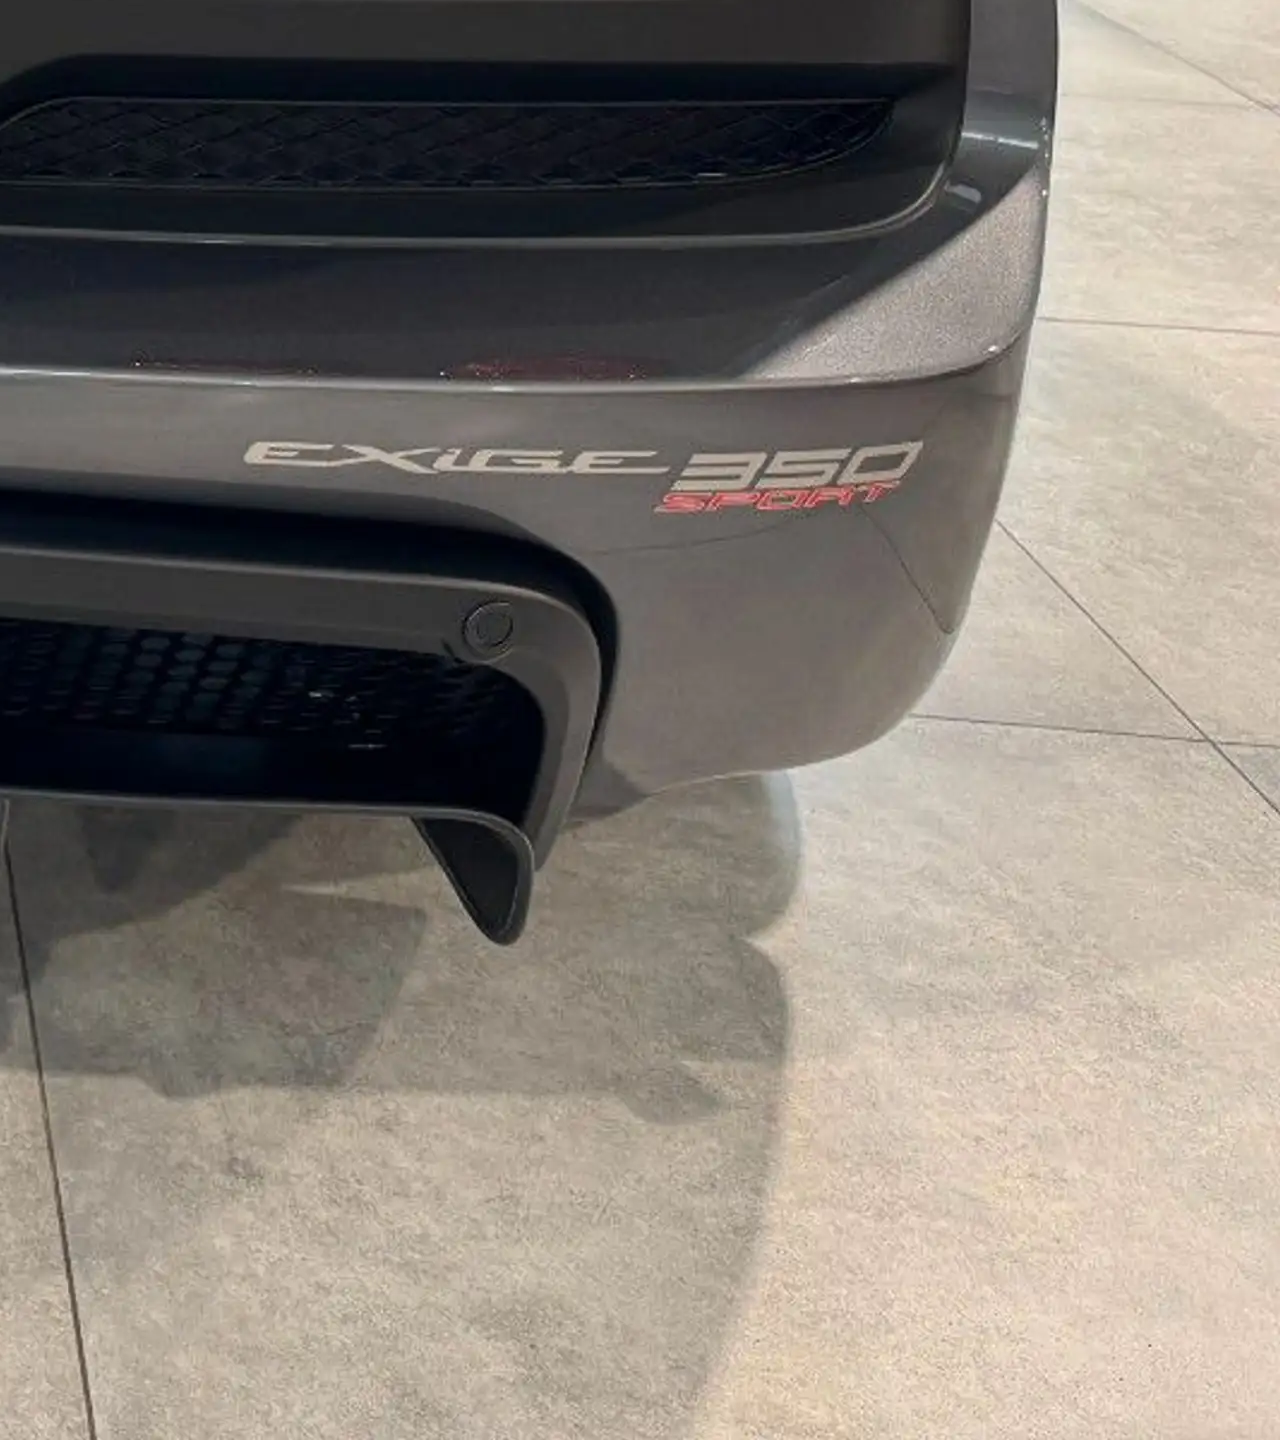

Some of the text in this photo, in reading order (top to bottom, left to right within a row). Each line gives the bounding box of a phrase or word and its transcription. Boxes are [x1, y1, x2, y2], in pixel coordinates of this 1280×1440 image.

[243, 440, 924, 491] EXIGE 350
[654, 481, 901, 513] SPORT
